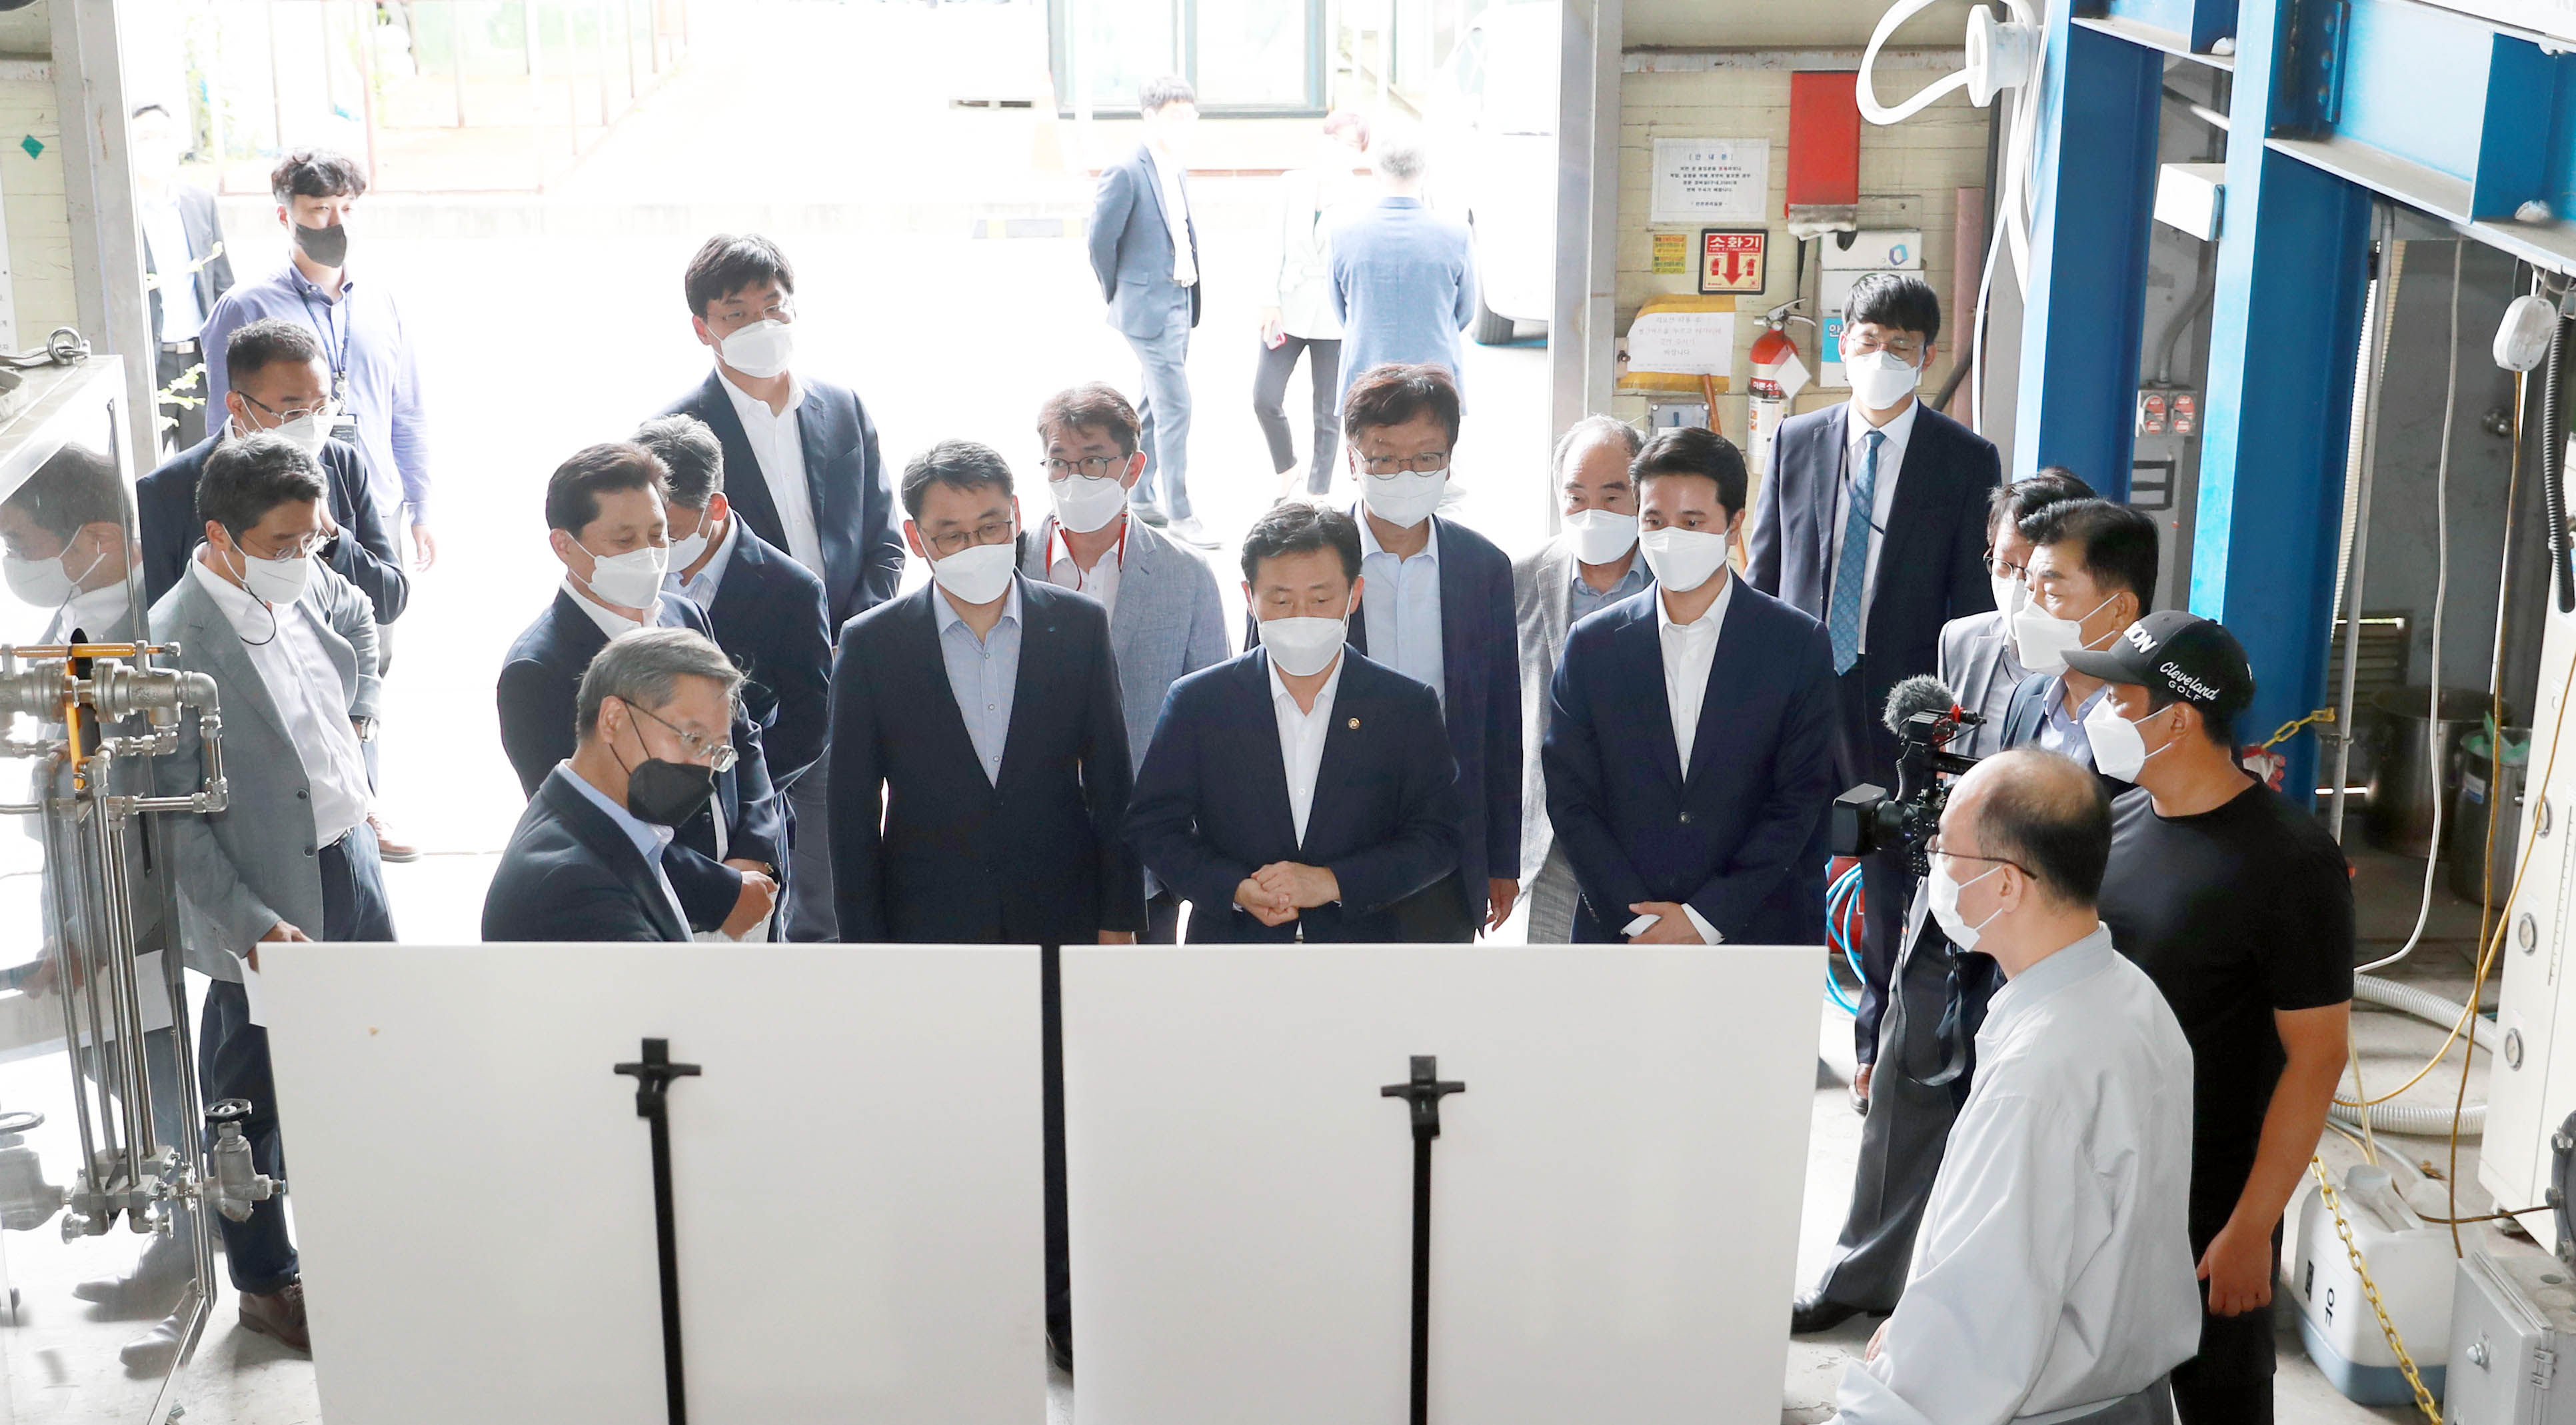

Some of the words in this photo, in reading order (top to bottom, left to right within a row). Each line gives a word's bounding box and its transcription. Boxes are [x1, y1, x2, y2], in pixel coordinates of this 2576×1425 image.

[1709, 237, 1760, 248] 소화기
[2159, 661, 2220, 701] Cleveland
[2168, 680, 2202, 701] GOLF
